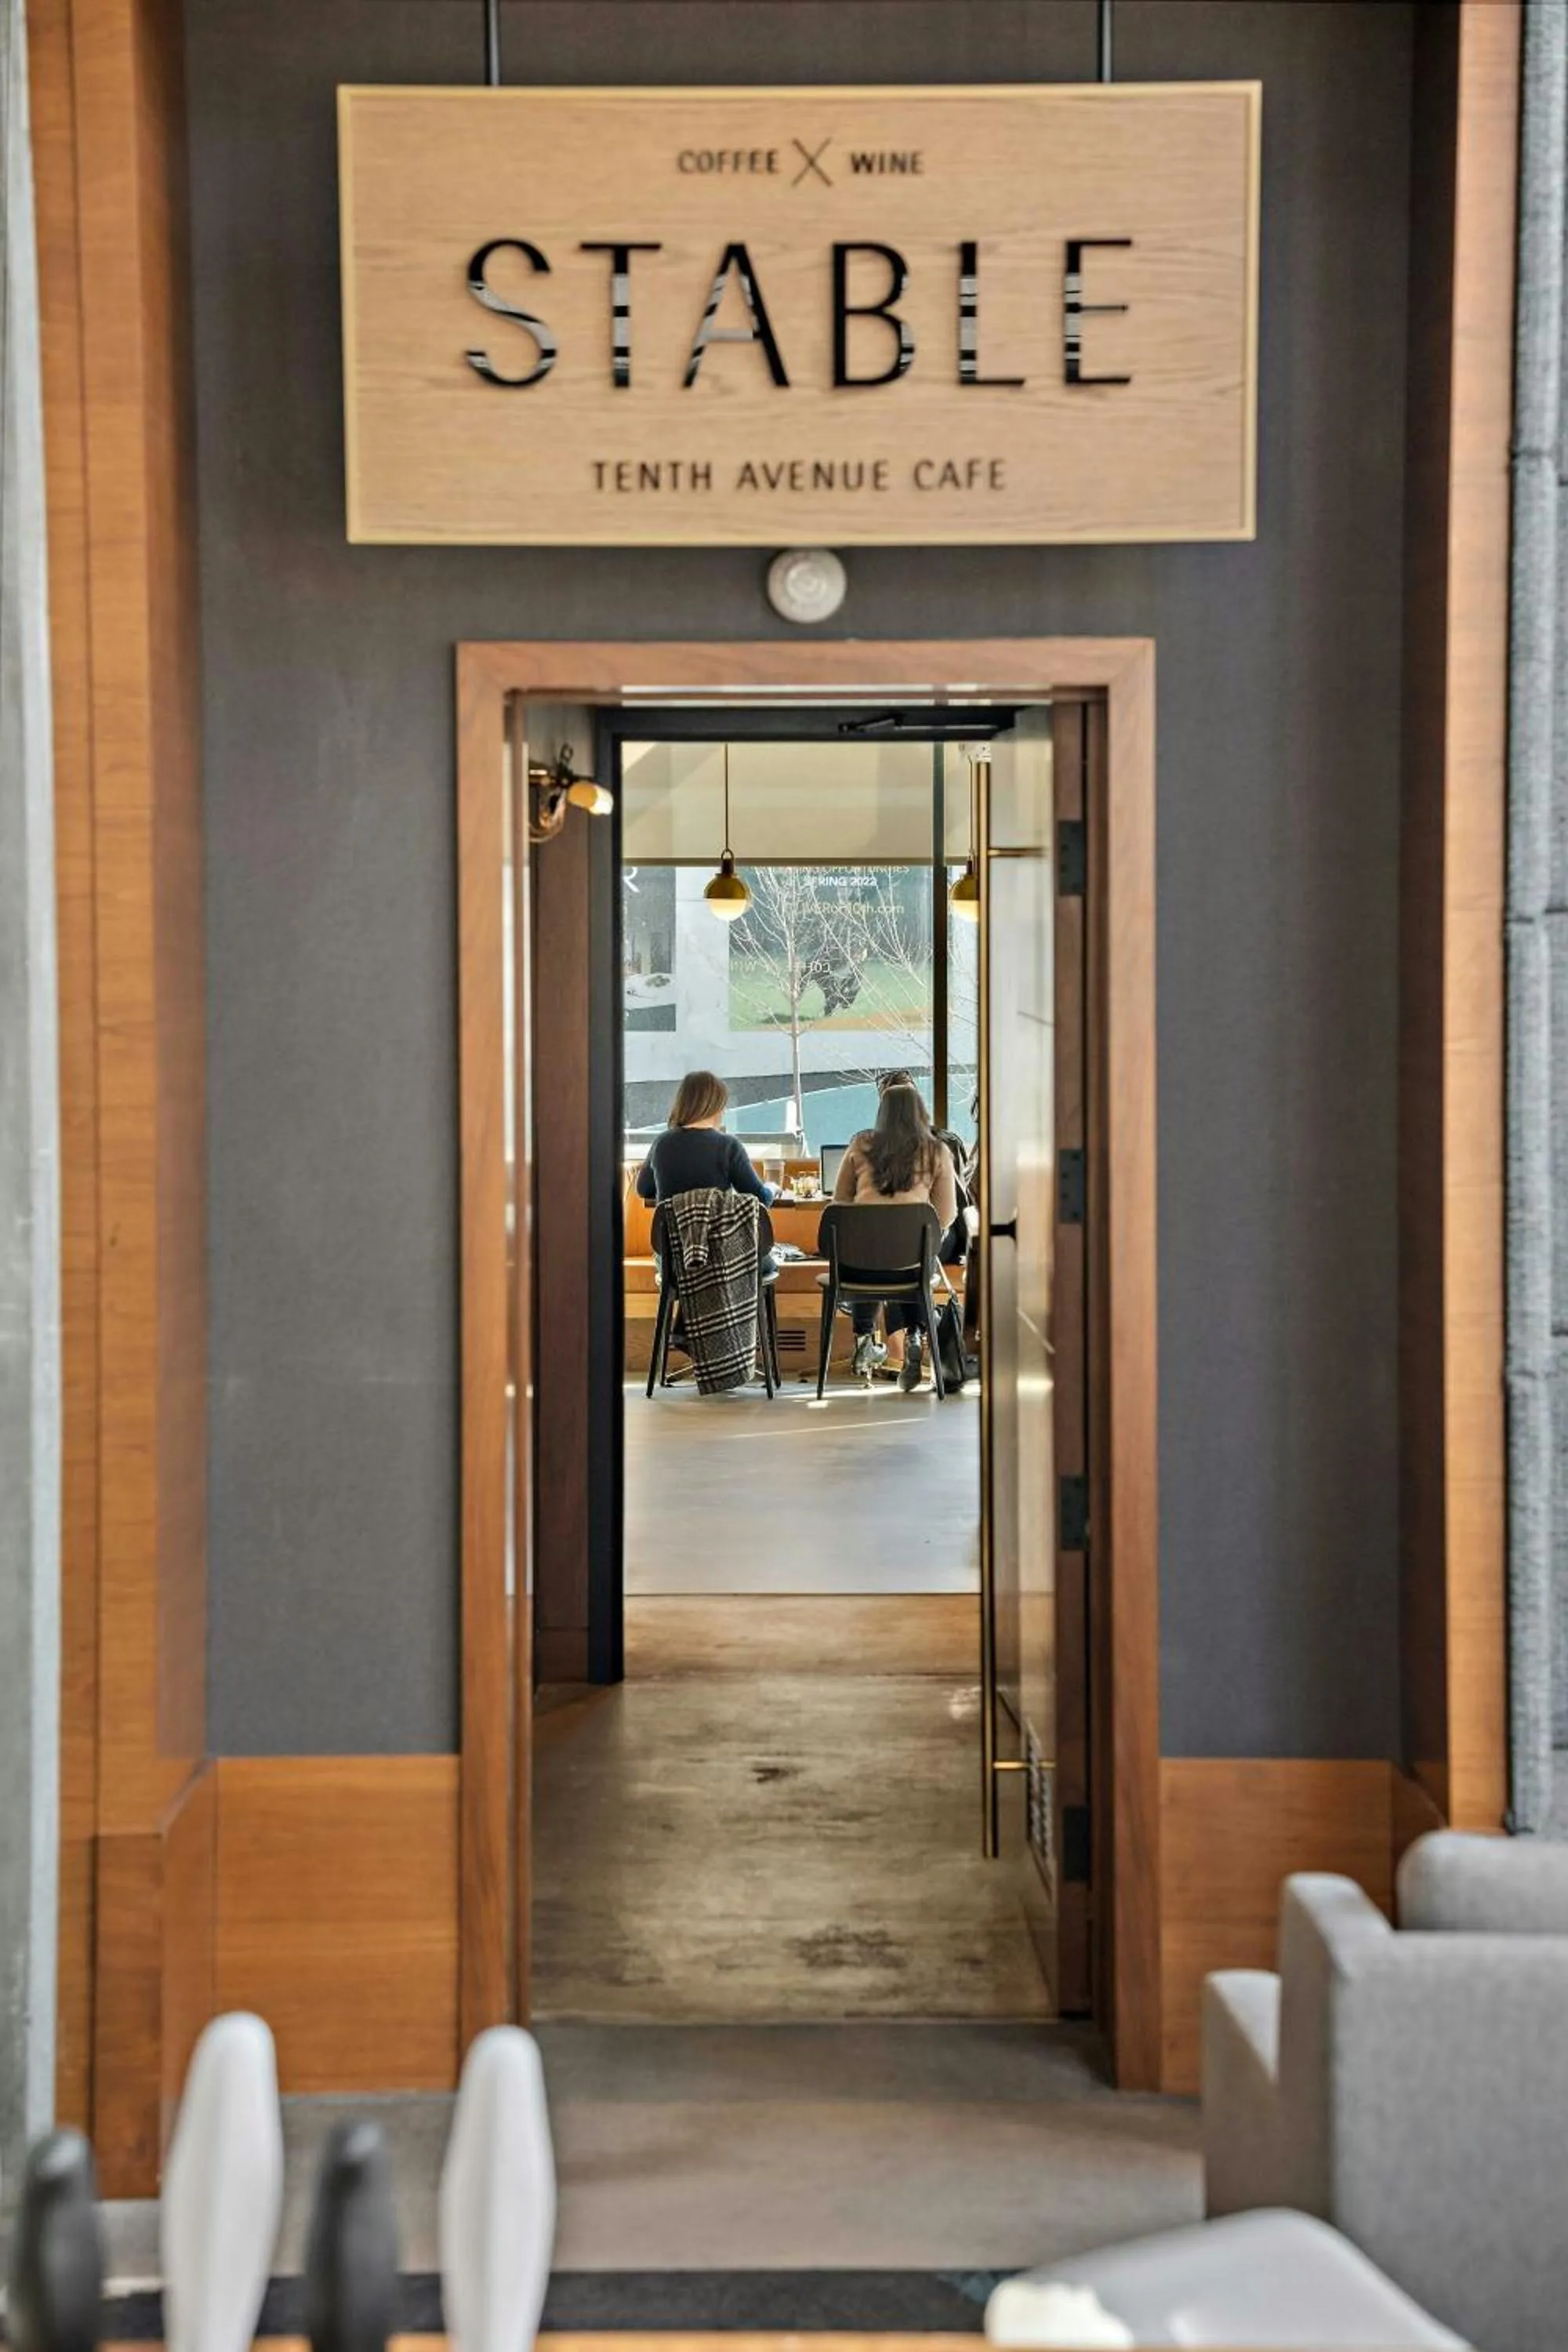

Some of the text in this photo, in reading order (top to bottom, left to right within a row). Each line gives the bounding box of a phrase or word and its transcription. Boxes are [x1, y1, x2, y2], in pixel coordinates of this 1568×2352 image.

[677, 138, 924, 187] COFFEE X WINE
[464, 238, 1134, 390] STABLE
[593, 459, 1007, 492] TENTH AVENUE CAFE
